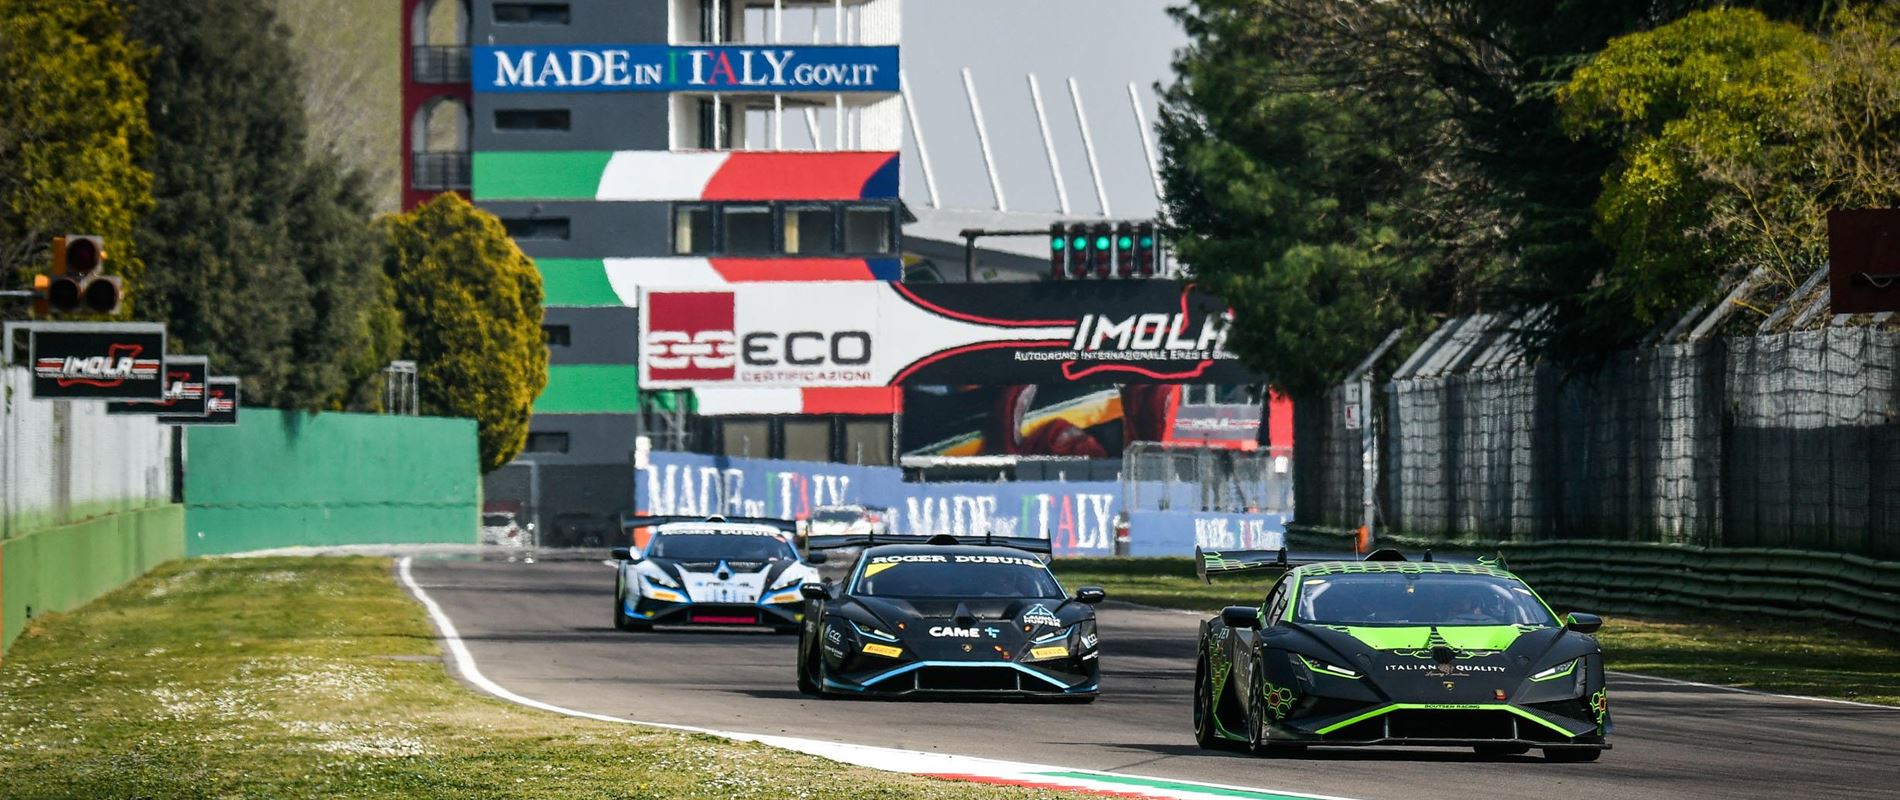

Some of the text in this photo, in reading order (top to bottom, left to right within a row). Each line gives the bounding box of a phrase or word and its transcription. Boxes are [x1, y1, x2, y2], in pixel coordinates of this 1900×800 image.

[494, 50, 632, 86] MADE
[635, 64, 662, 85] IN
[1073, 313, 1234, 351] IMOLA
[742, 331, 872, 366] ECO
[1014, 350, 1077, 361] AUTODROMO
[1081, 350, 1167, 360] INTERNAZIONALE
[63, 356, 134, 375] IMOLA
[742, 371, 871, 382] CERTIFICAZIONI
[872, 555, 1035, 566] ROGER DUBUIS
[928, 626, 981, 638] CAME
